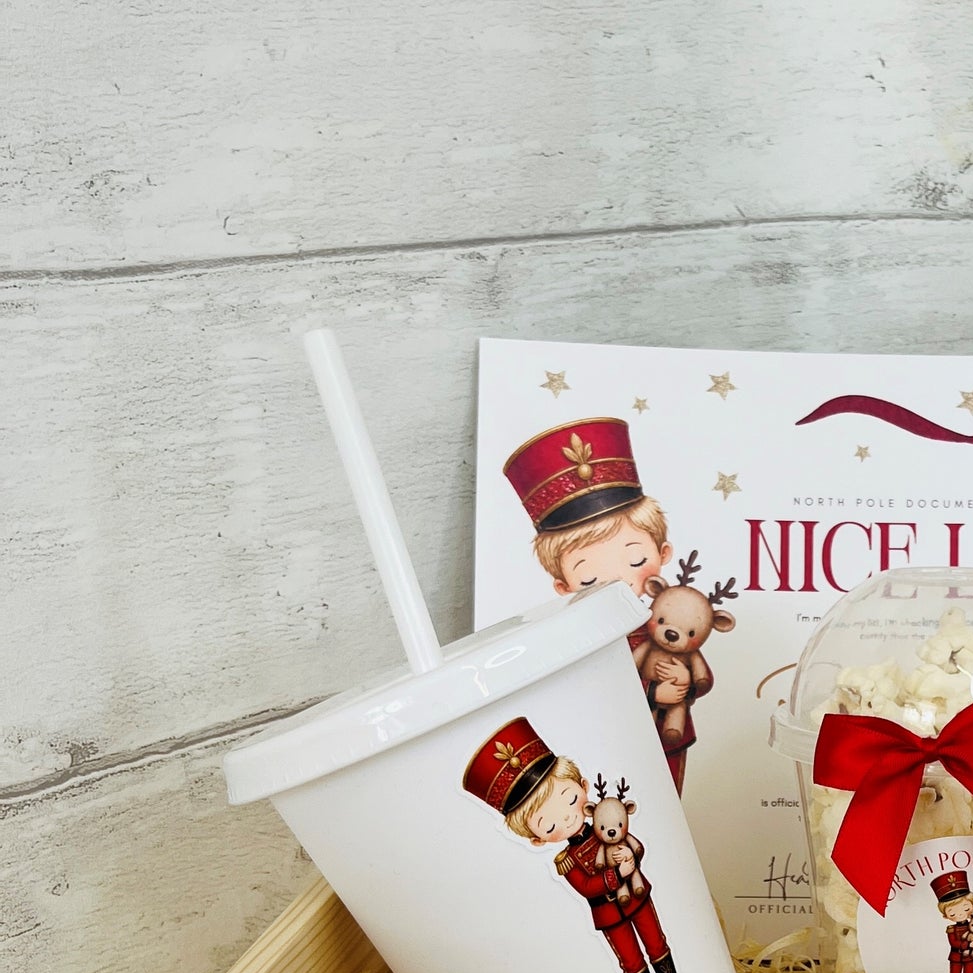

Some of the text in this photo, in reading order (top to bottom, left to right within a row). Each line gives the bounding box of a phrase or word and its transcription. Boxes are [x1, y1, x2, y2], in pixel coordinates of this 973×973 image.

[793, 496, 846, 507] NORTH
[856, 498, 895, 509] POLE
[743, 518, 918, 599] NICE
[748, 904, 814, 915] OFFICIAL
